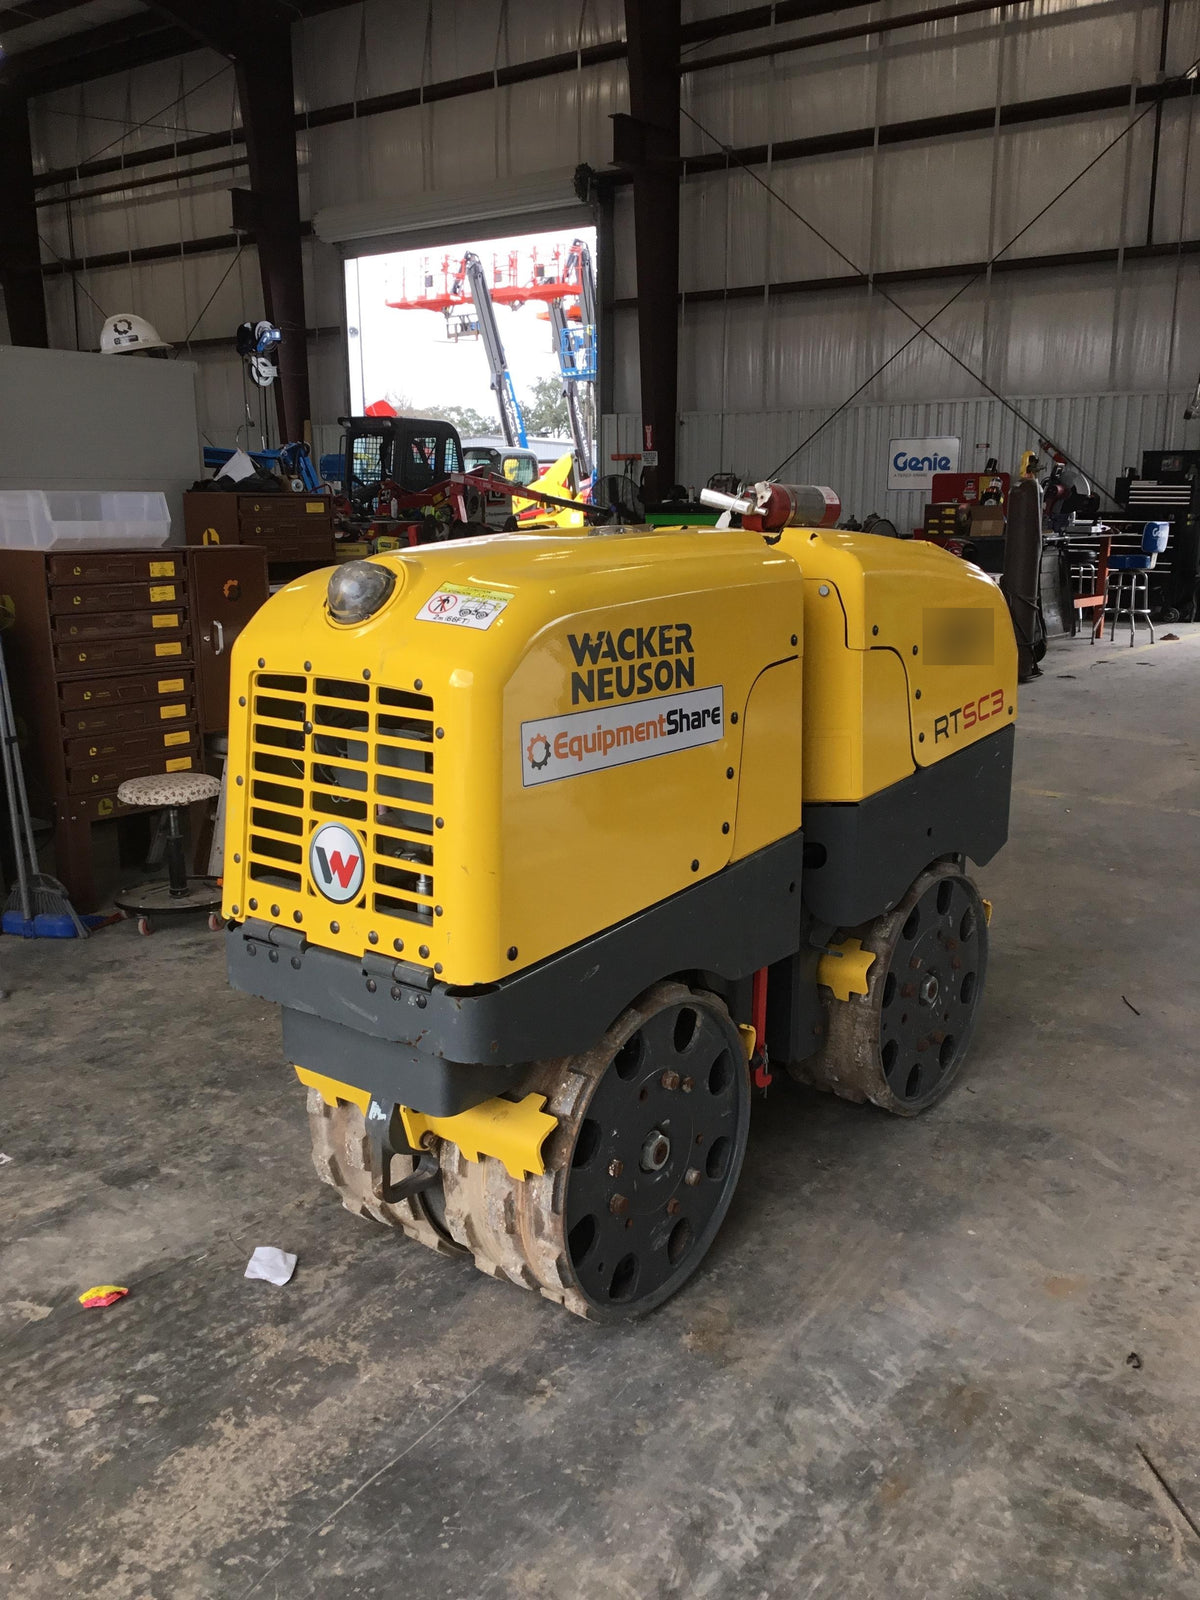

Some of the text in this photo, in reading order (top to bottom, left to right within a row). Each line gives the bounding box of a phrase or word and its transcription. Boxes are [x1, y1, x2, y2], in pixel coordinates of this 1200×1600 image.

[893, 452, 951, 472] Genie
[567, 623, 695, 667] WACKER
[571, 656, 695, 705] NEUSON
[553, 706, 721, 762] EquipmentShare
